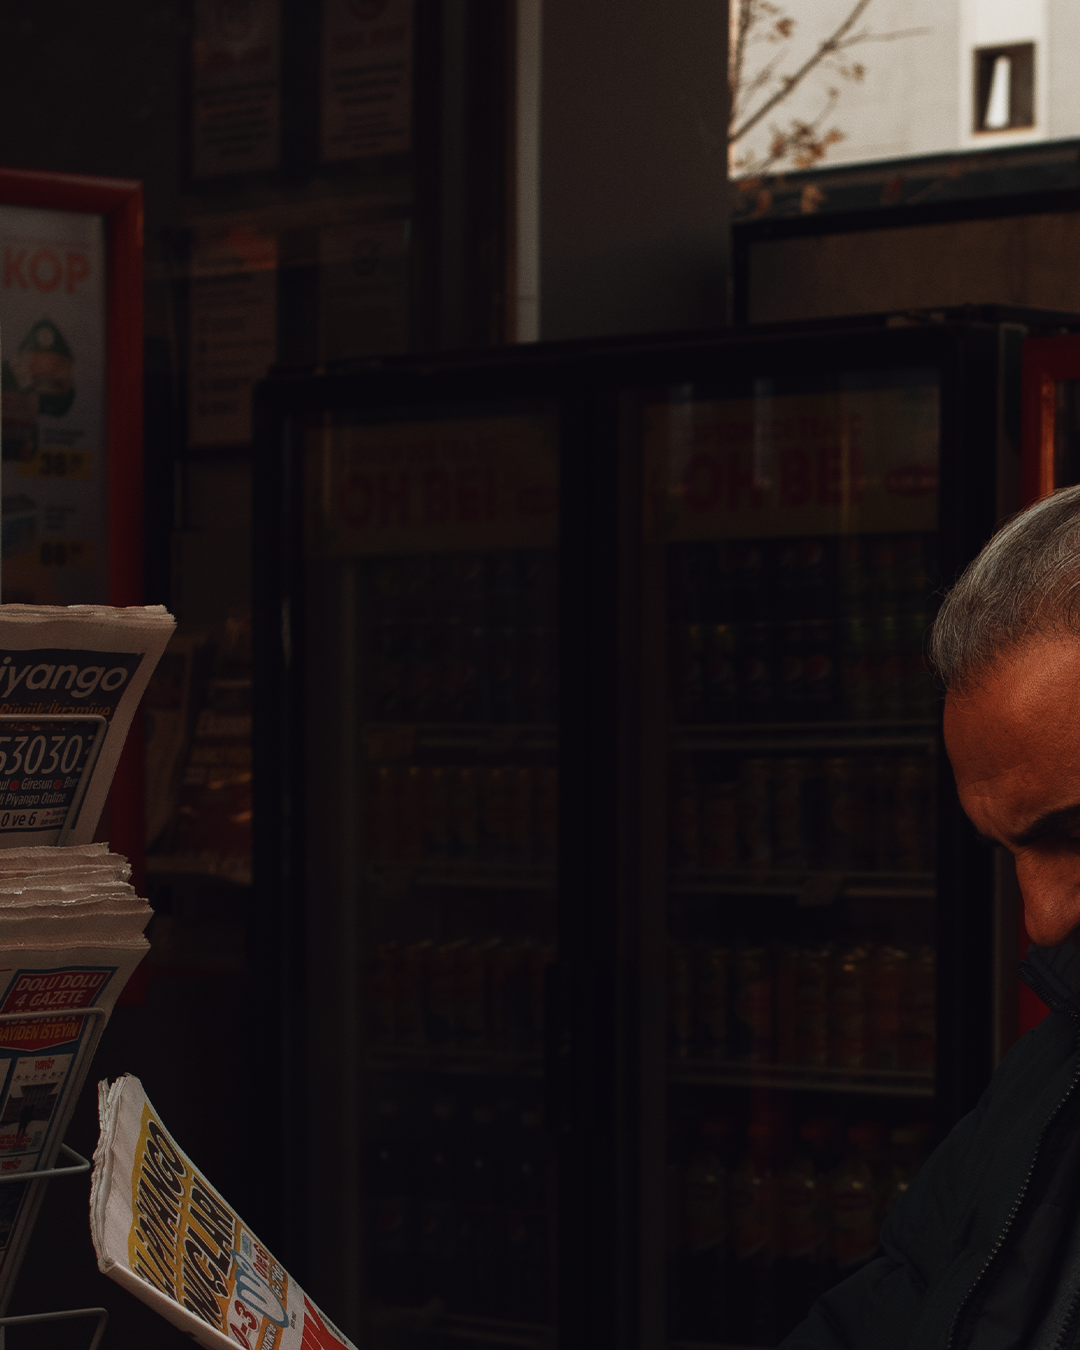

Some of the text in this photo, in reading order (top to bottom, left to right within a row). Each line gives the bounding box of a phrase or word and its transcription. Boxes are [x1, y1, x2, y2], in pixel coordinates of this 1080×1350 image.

[3, 247, 91, 294] KOP
[21, 777, 53, 791] Giresun
[5, 792, 40, 808] Piyango
[40, 791, 67, 805] Online
[12, 814, 26, 826] ve
[28, 810, 38, 826] 6
[15, 974, 104, 992] DOLU DOLU
[14, 989, 88, 1008] 4 GAZETE
